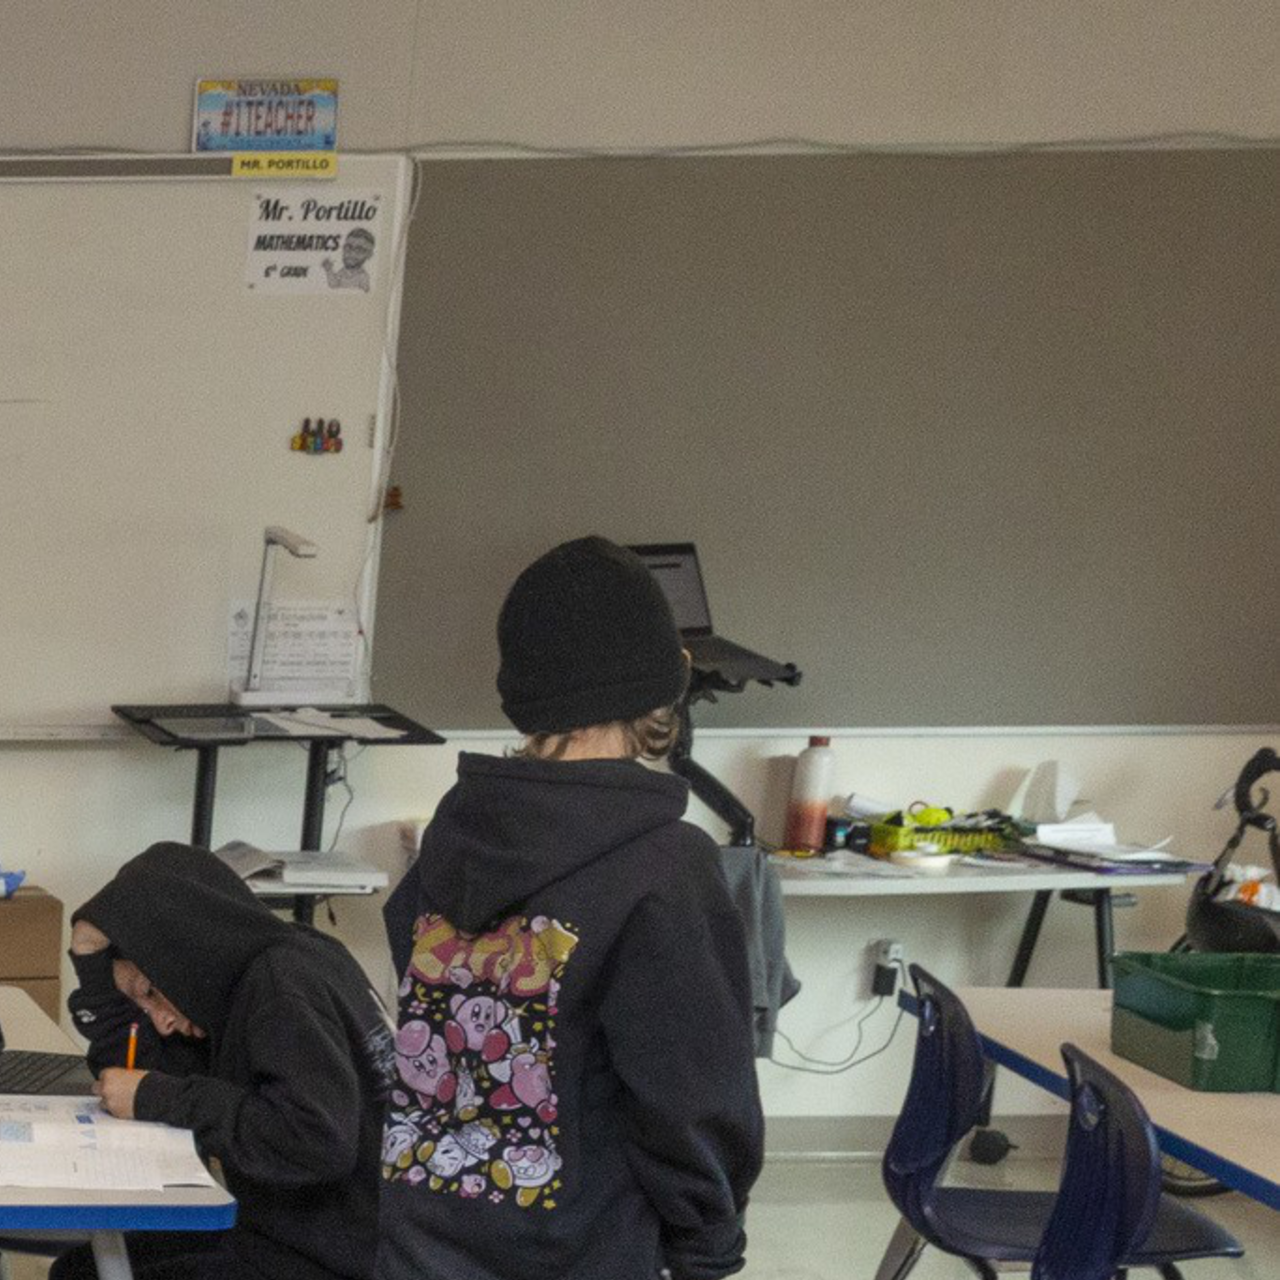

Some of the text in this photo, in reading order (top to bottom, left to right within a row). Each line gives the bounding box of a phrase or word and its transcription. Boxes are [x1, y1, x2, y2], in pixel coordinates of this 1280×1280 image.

[238, 82, 303, 96] NEVADA
[247, 100, 315, 136] TEACHER
[240, 159, 329, 169] MR. PORTILLO
[259, 199, 377, 221] Mr. Portillo
[253, 234, 341, 251] MATHEMATICS
